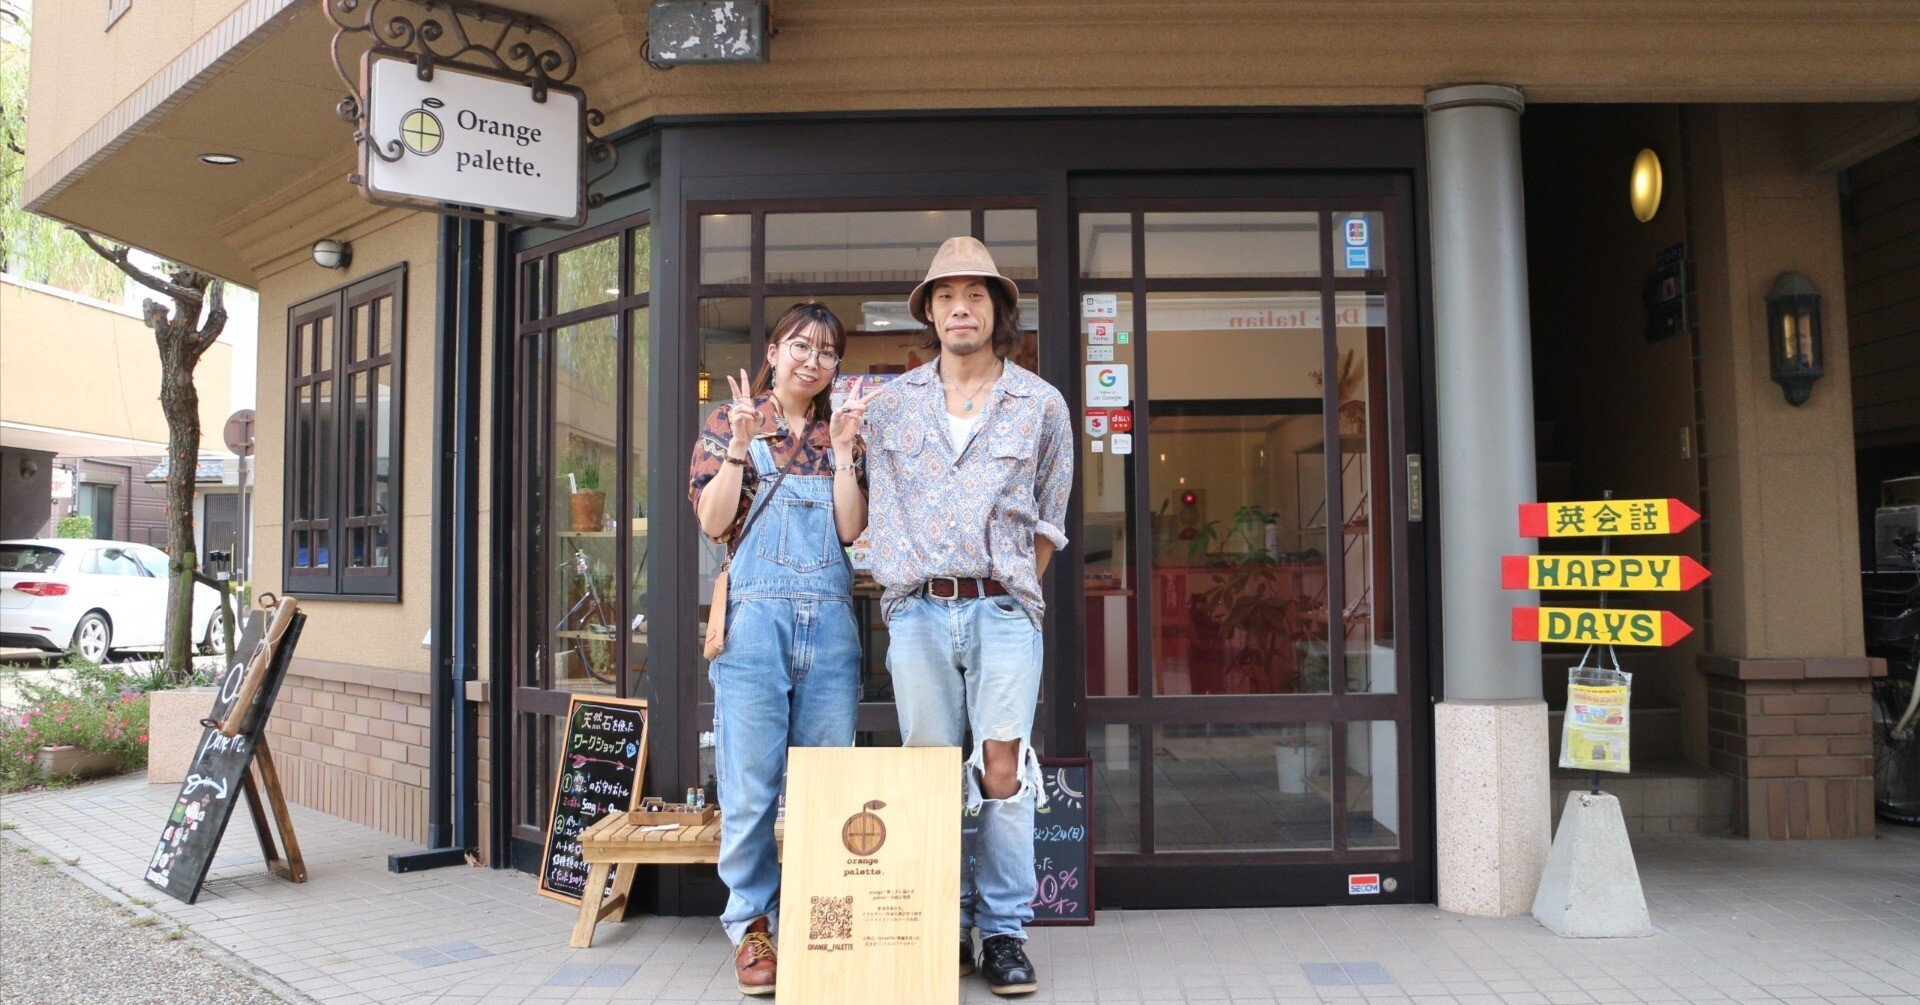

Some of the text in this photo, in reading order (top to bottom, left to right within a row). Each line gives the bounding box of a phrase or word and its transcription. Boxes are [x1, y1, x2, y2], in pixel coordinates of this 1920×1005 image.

[457, 109, 542, 147] Orange
[456, 149, 541, 178] palette.
[1556, 503, 1658, 533] 英会話
[1536, 558, 1671, 588] HAPPY
[1548, 612, 1654, 642] DAYS
[581, 711, 634, 732] 天然石を使った
[573, 734, 627, 754] ワークショップ
[847, 858, 879, 866] orange
[1033, 856, 1054, 871] った
[843, 868, 885, 877] palette.
[1350, 884, 1379, 893] SECOM
[1048, 897, 1079, 914] オフ
[807, 943, 854, 952] ORANGE_PALETTE
